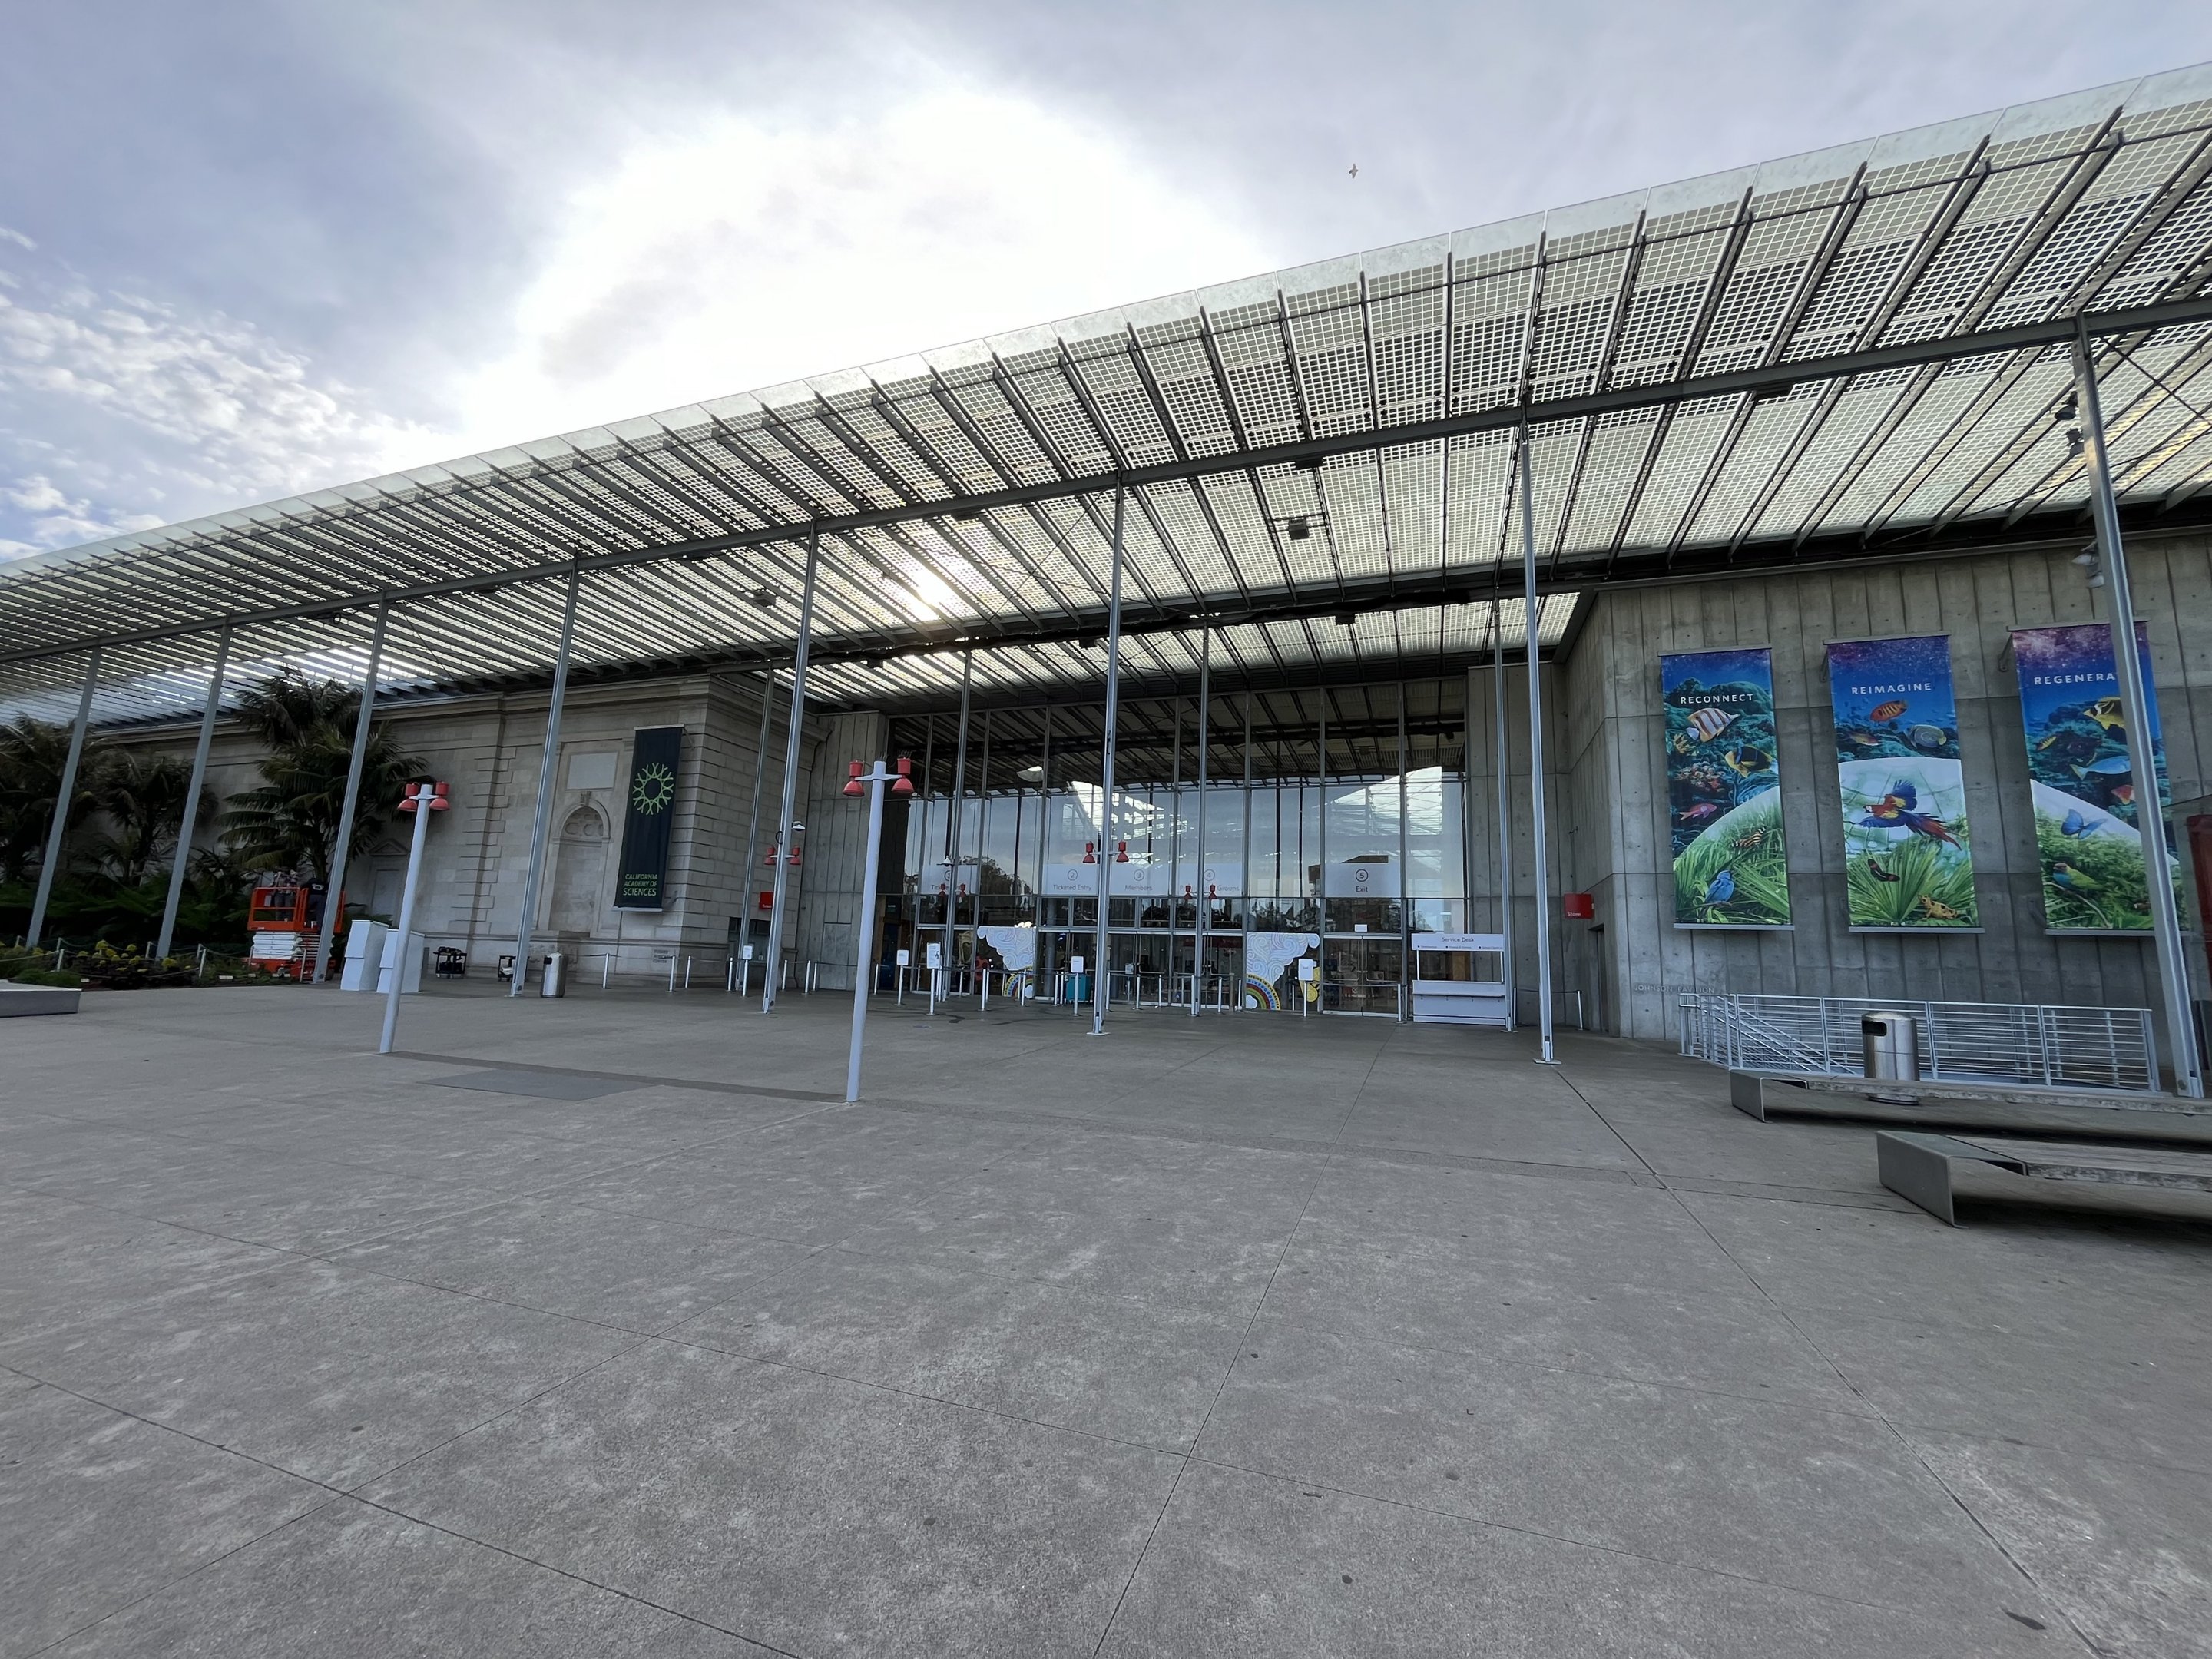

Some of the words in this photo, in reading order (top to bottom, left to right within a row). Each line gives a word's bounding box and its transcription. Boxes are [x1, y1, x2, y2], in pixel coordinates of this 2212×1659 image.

[2034, 673, 2117, 685] REGENERA
[1851, 683, 1932, 695] REIMAGINE
[1680, 694, 1753, 704] RECONNECT
[623, 888, 657, 896] SCIENCES
[1634, 984, 1673, 992] JOHNSON
